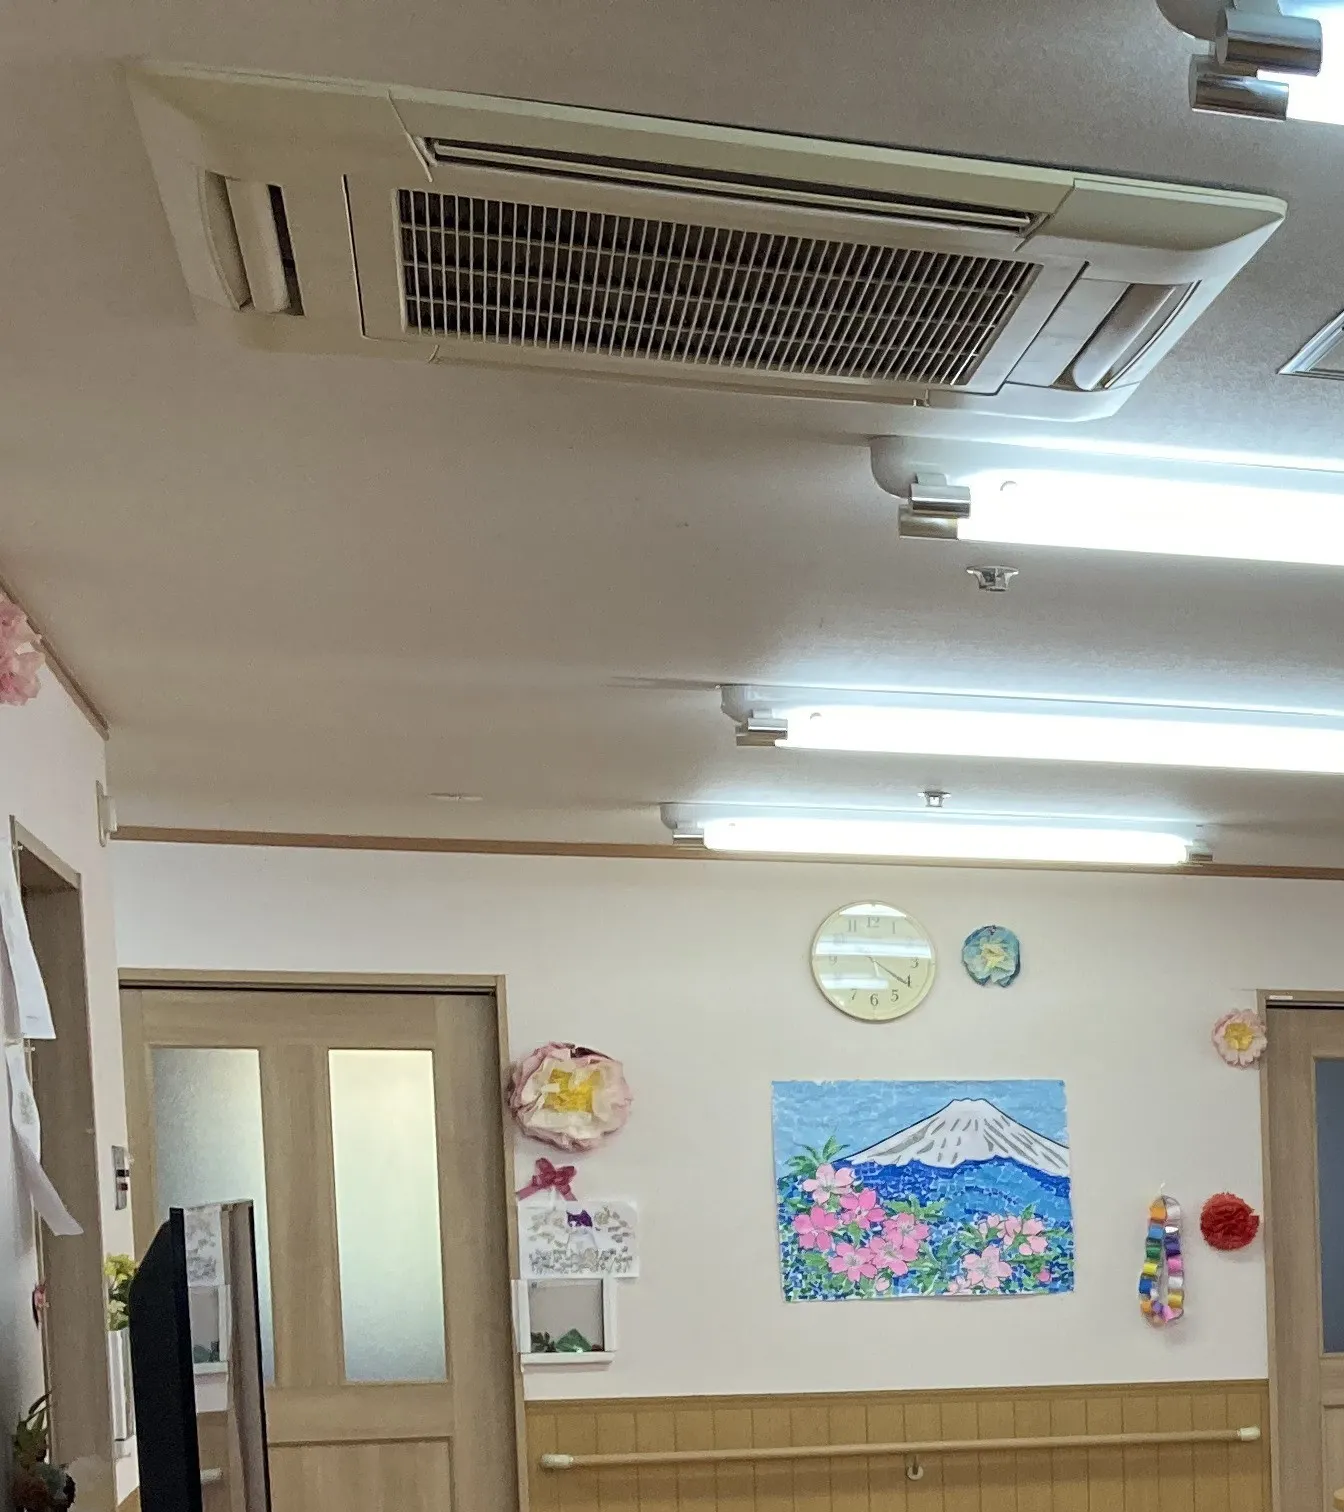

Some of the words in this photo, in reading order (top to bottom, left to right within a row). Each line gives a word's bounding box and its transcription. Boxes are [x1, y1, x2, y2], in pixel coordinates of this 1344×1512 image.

[847, 919, 857, 932] 11
[866, 916, 880, 928] 12
[910, 957, 919, 968] 3
[850, 988, 858, 1001] 7
[869, 993, 879, 1006] 6
[890, 989, 899, 1002] 5
